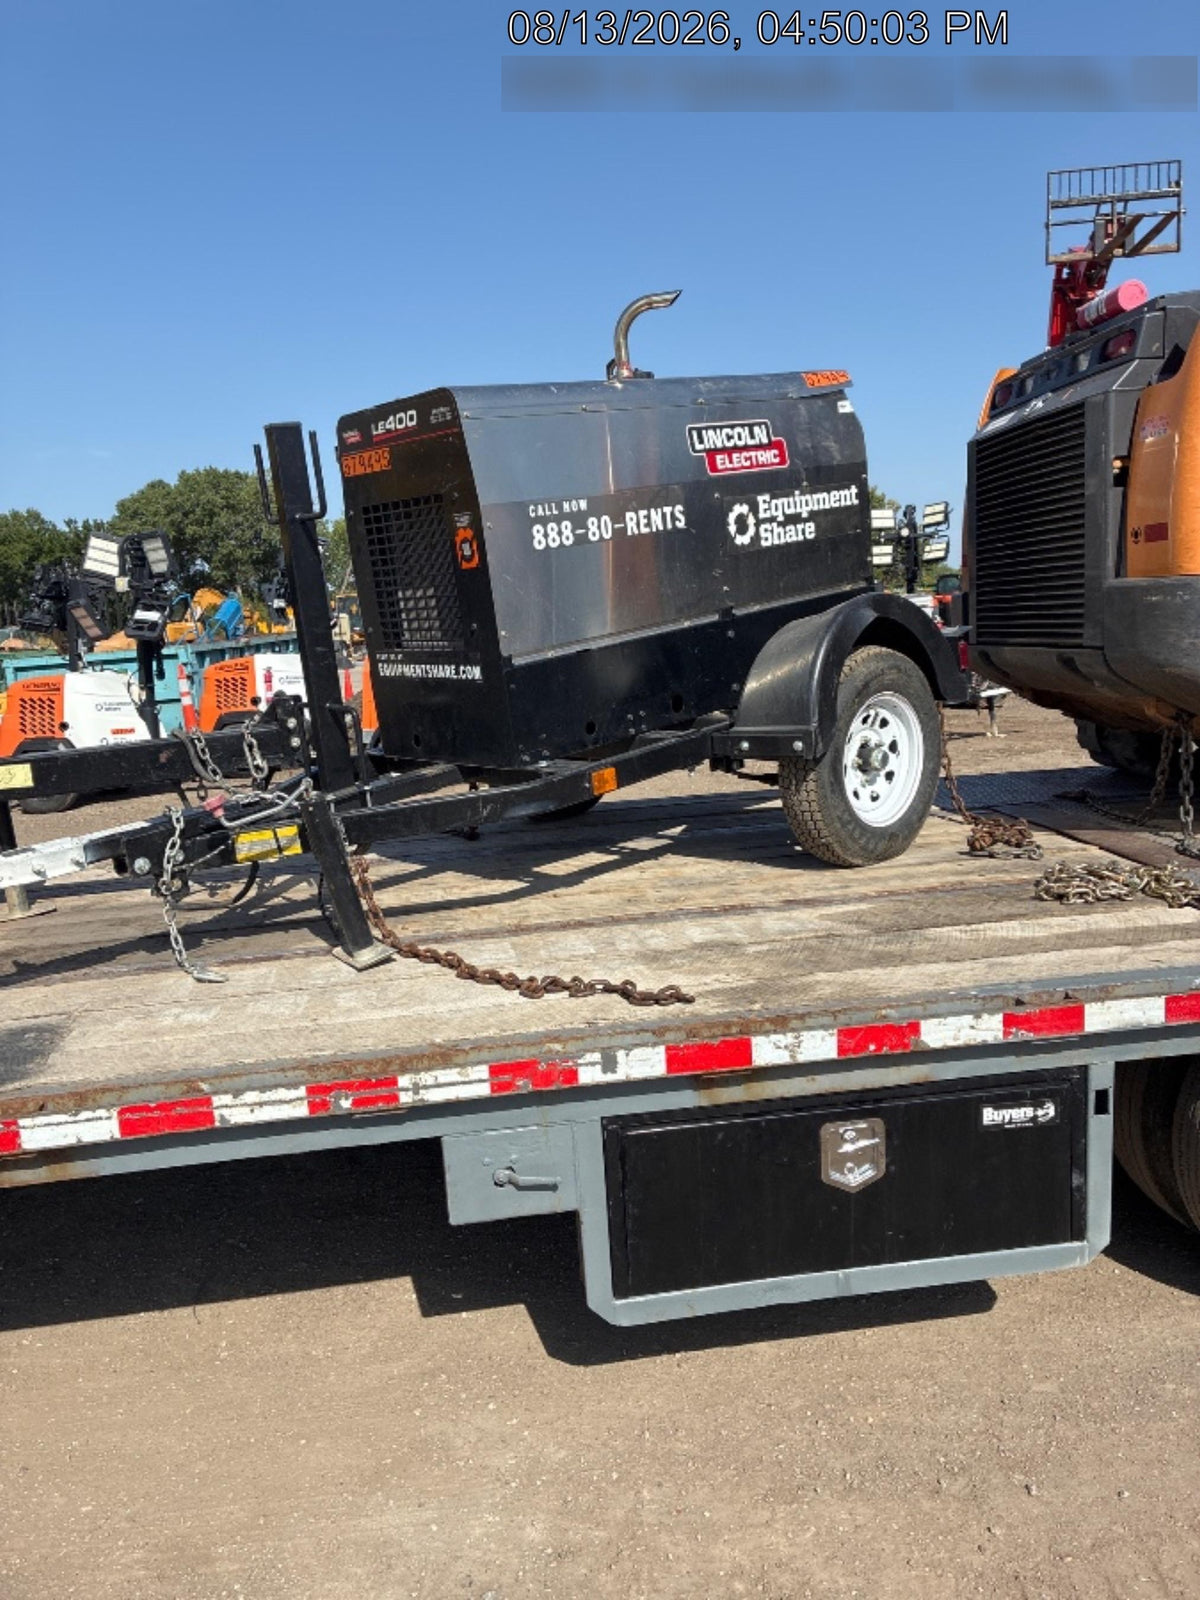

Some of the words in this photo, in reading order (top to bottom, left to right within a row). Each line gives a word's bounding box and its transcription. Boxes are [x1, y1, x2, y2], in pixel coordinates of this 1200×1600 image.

[371, 409, 417, 435] LE400
[691, 424, 768, 450] LINCOLN
[715, 449, 780, 470] ELECTRIC
[529, 503, 559, 517] CALL
[563, 499, 588, 513] NOW
[757, 485, 859, 521] Equipment
[532, 504, 687, 550] 888-80-RENTS
[759, 520, 817, 547] Share
[378, 663, 483, 680] EQUIPMENTSHARE.COM
[983, 1107, 1034, 1124] Buyers
